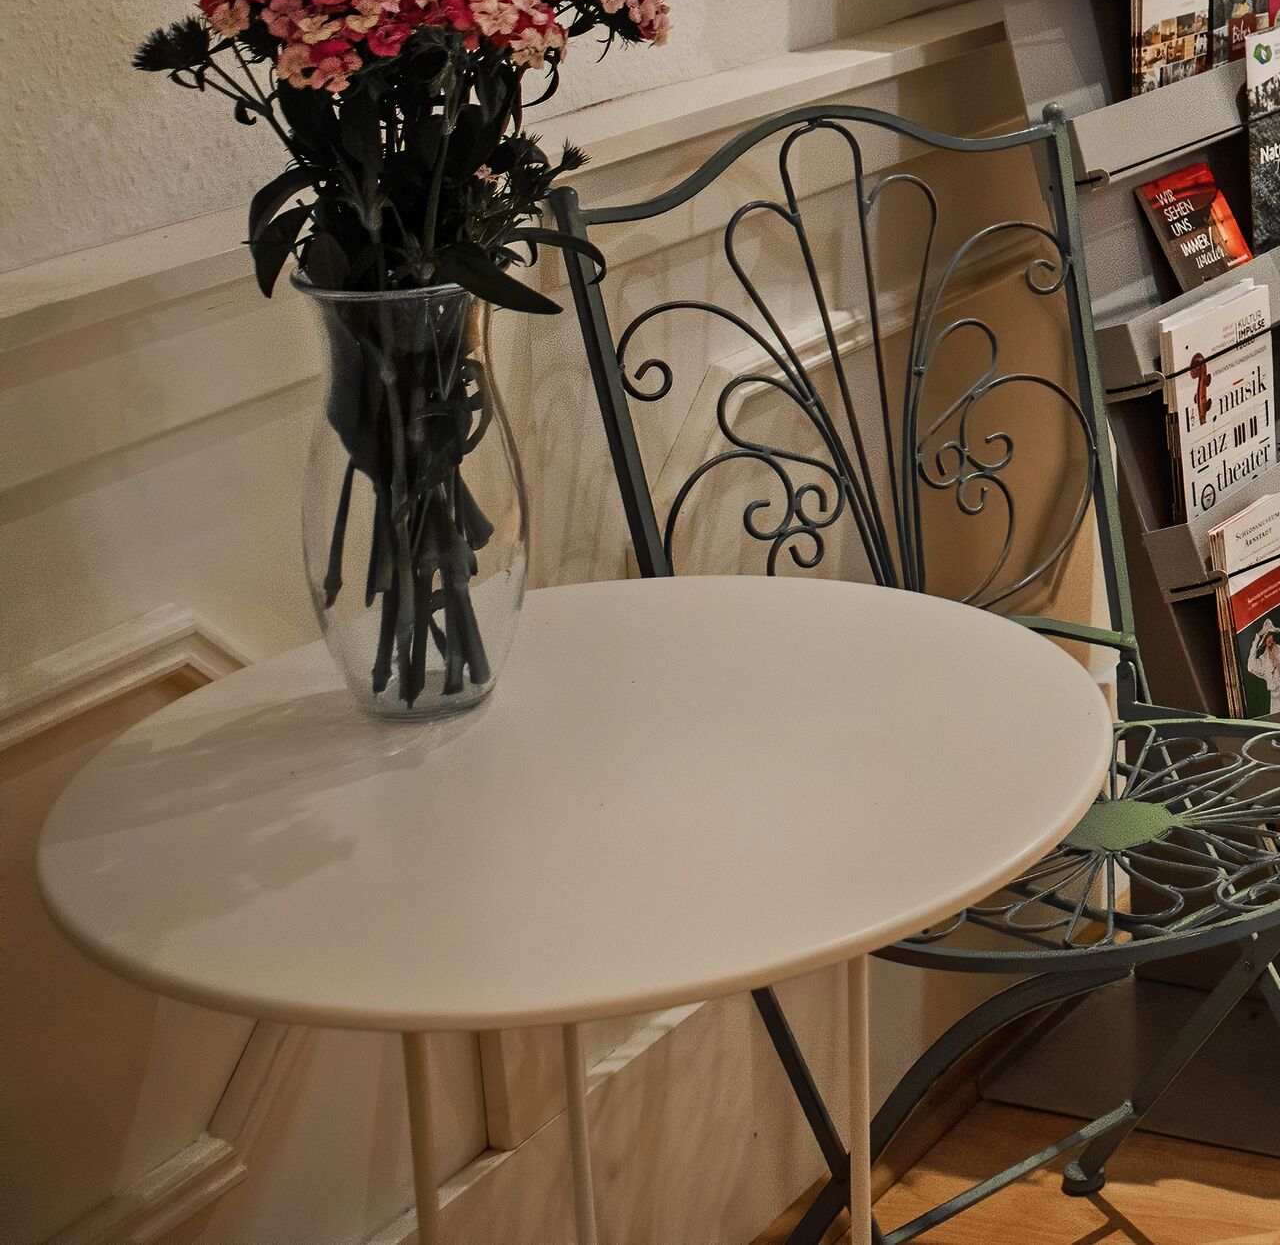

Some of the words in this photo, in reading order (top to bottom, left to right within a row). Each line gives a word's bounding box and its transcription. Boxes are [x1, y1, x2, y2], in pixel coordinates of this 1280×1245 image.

[1155, 189, 1177, 206] WIR
[1163, 199, 1195, 222] SEHEN
[1170, 218, 1196, 237] UNS.
[1180, 233, 1211, 257] IMMER
[1238, 309, 1263, 329] KULTUR
[1238, 318, 1266, 340] IMPULSE
[1219, 366, 1268, 416] musik
[1190, 433, 1228, 469] tanz
[1216, 442, 1271, 492] theater
